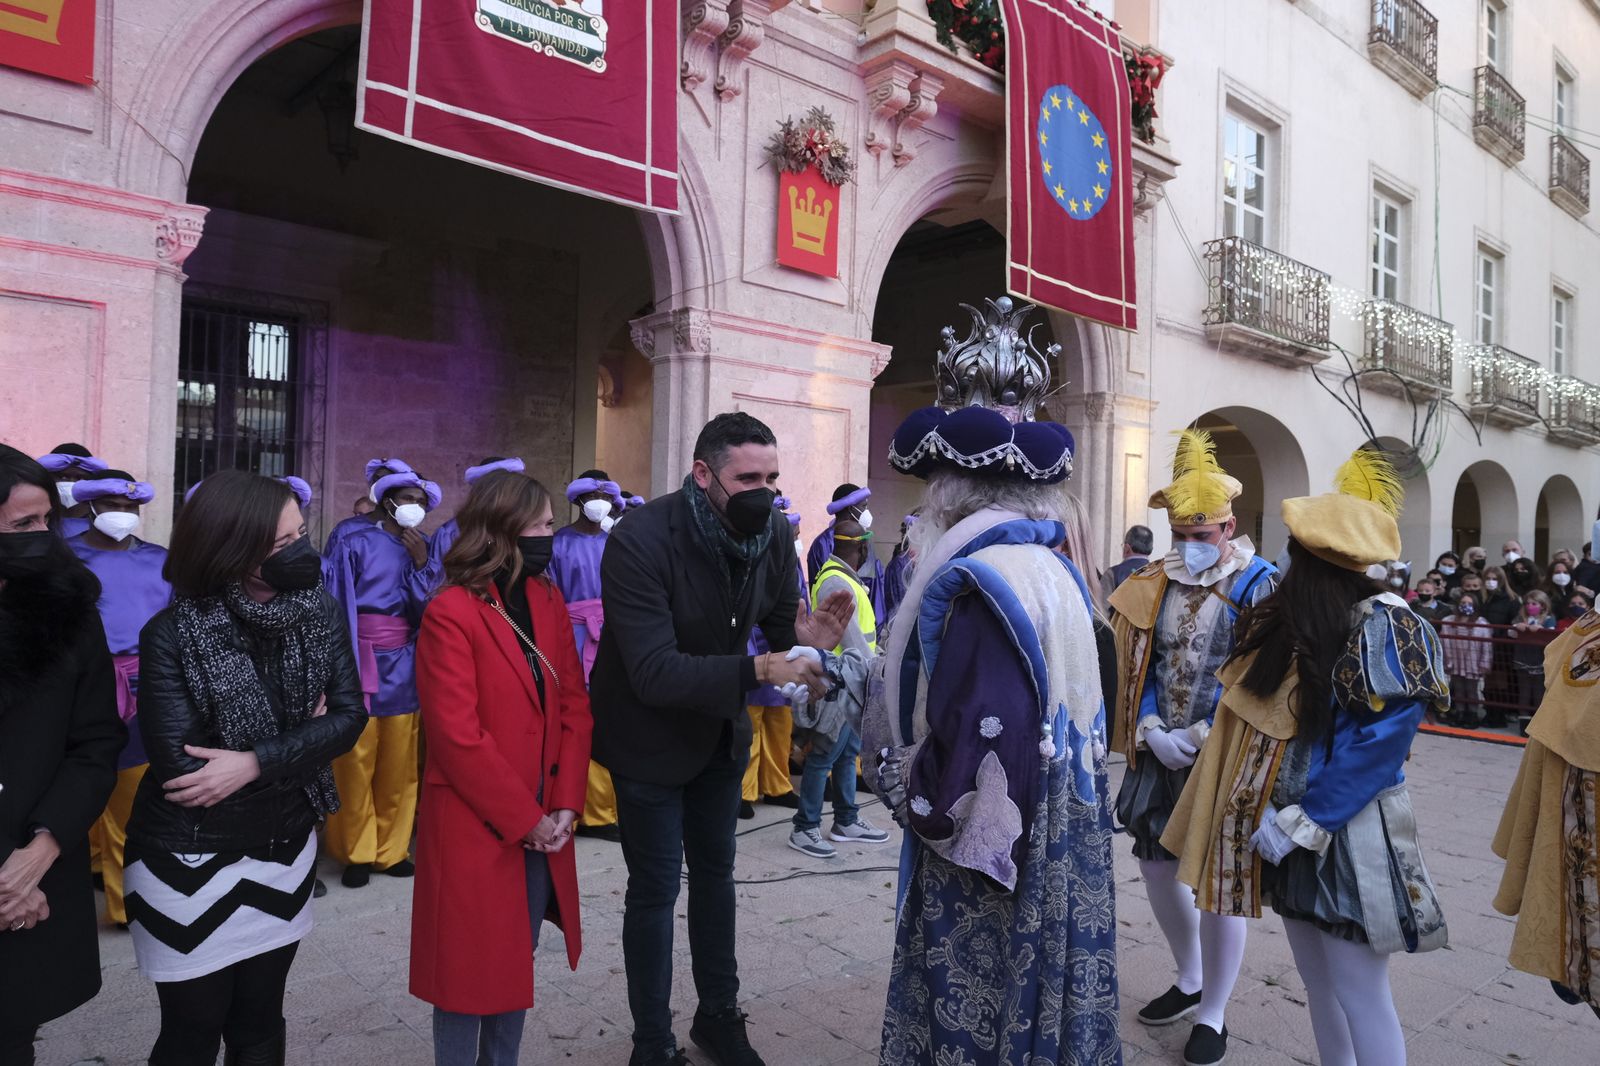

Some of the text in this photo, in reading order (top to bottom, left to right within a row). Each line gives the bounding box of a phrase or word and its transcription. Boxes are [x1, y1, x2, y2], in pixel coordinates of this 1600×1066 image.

[503, 0, 587, 32] DALVCIA POR SI
[498, 16, 589, 58] Y LA HVMANIDAD
